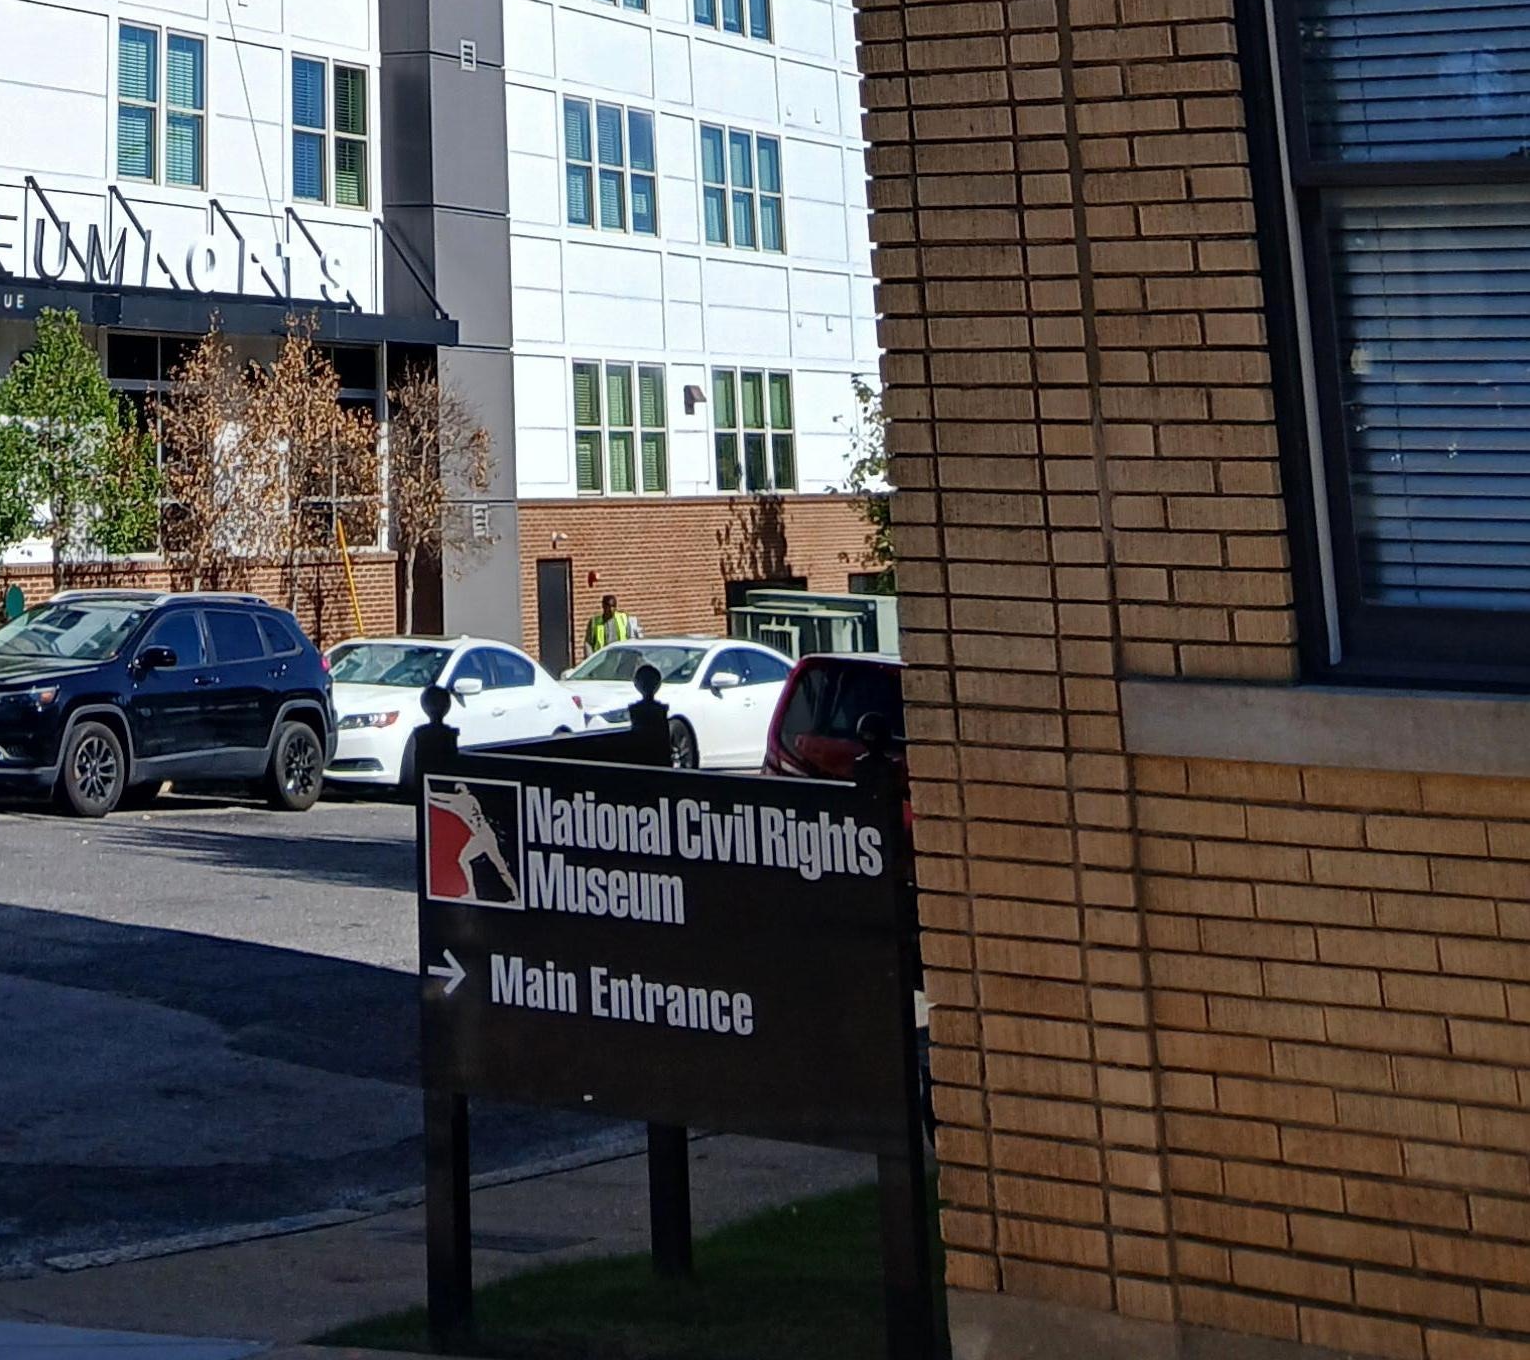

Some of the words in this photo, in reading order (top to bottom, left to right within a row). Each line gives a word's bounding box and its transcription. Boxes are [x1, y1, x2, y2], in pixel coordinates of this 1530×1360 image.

[526, 786, 670, 856] National
[676, 798, 757, 865] Civil
[760, 806, 883, 880] Rights
[528, 851, 685, 925] Museum
[490, 954, 577, 1014] Main
[591, 966, 754, 1036] Entrance
